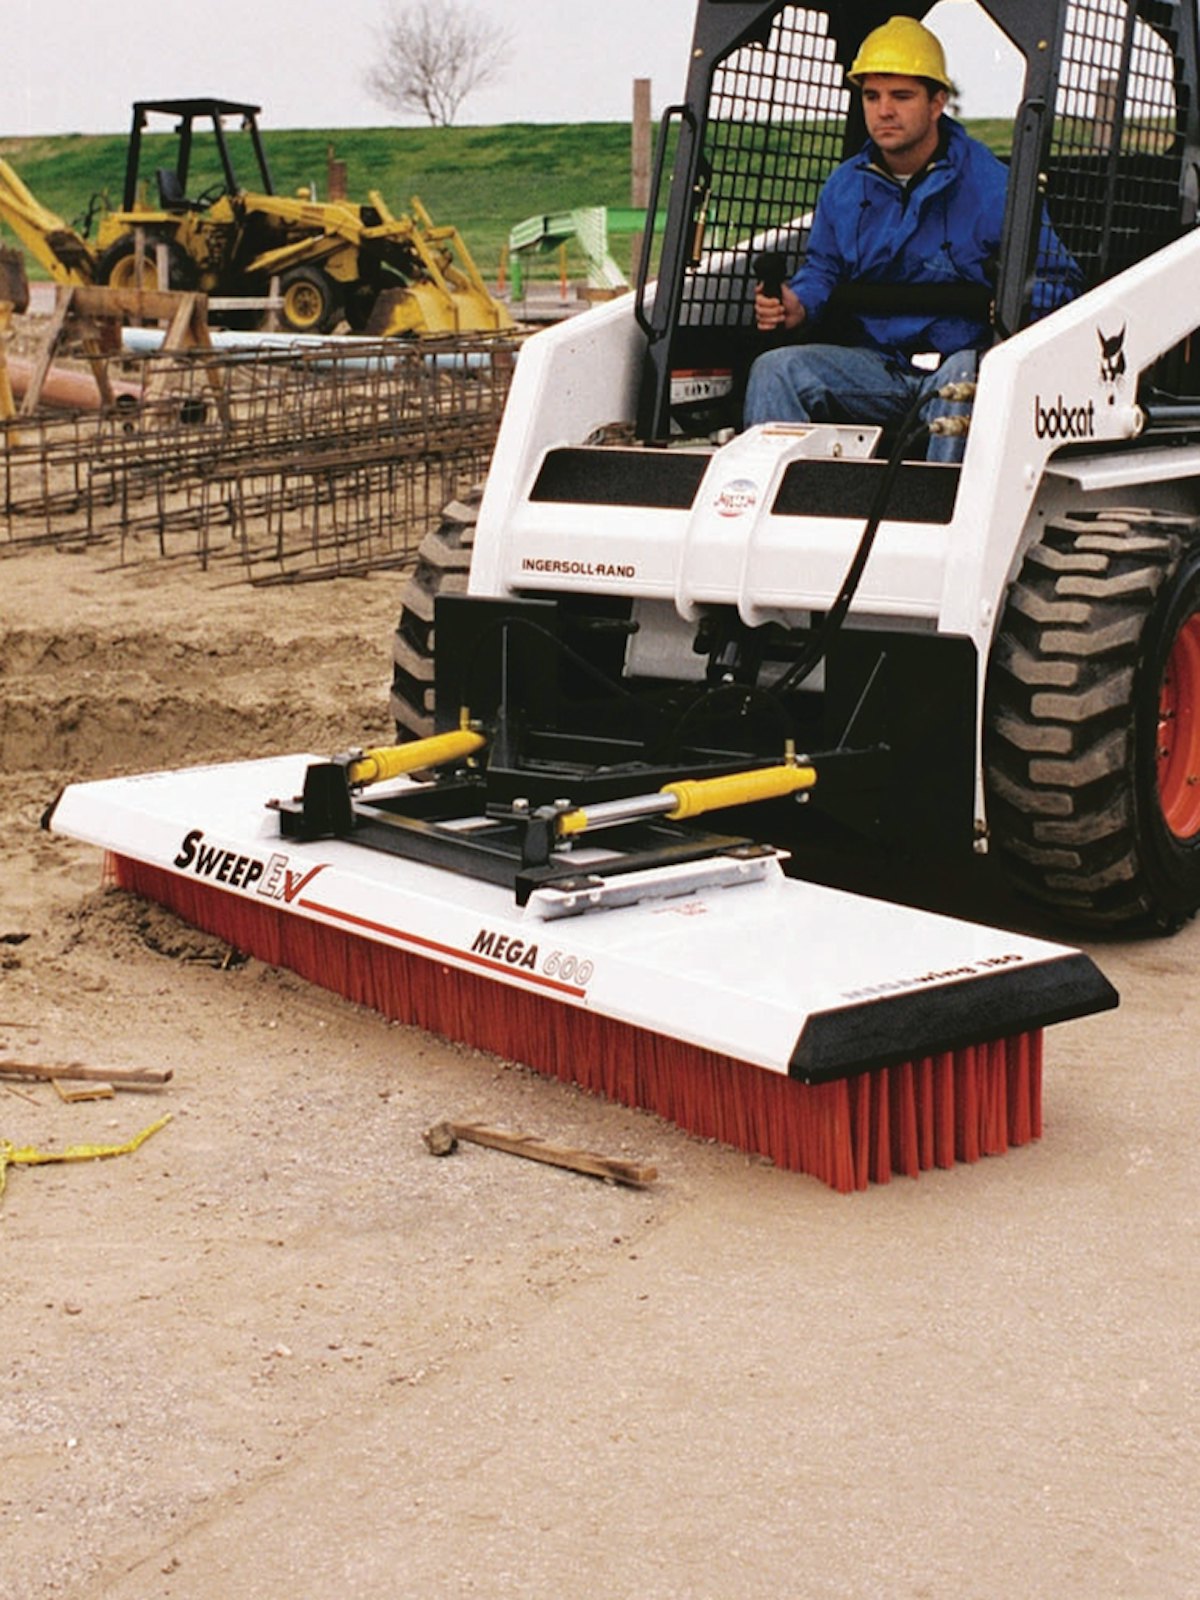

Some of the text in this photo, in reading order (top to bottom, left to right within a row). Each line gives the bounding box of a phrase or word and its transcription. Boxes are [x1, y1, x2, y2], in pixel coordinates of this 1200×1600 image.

[1034, 394, 1094, 439] bobcat
[470, 929, 595, 986] MEGA 600
